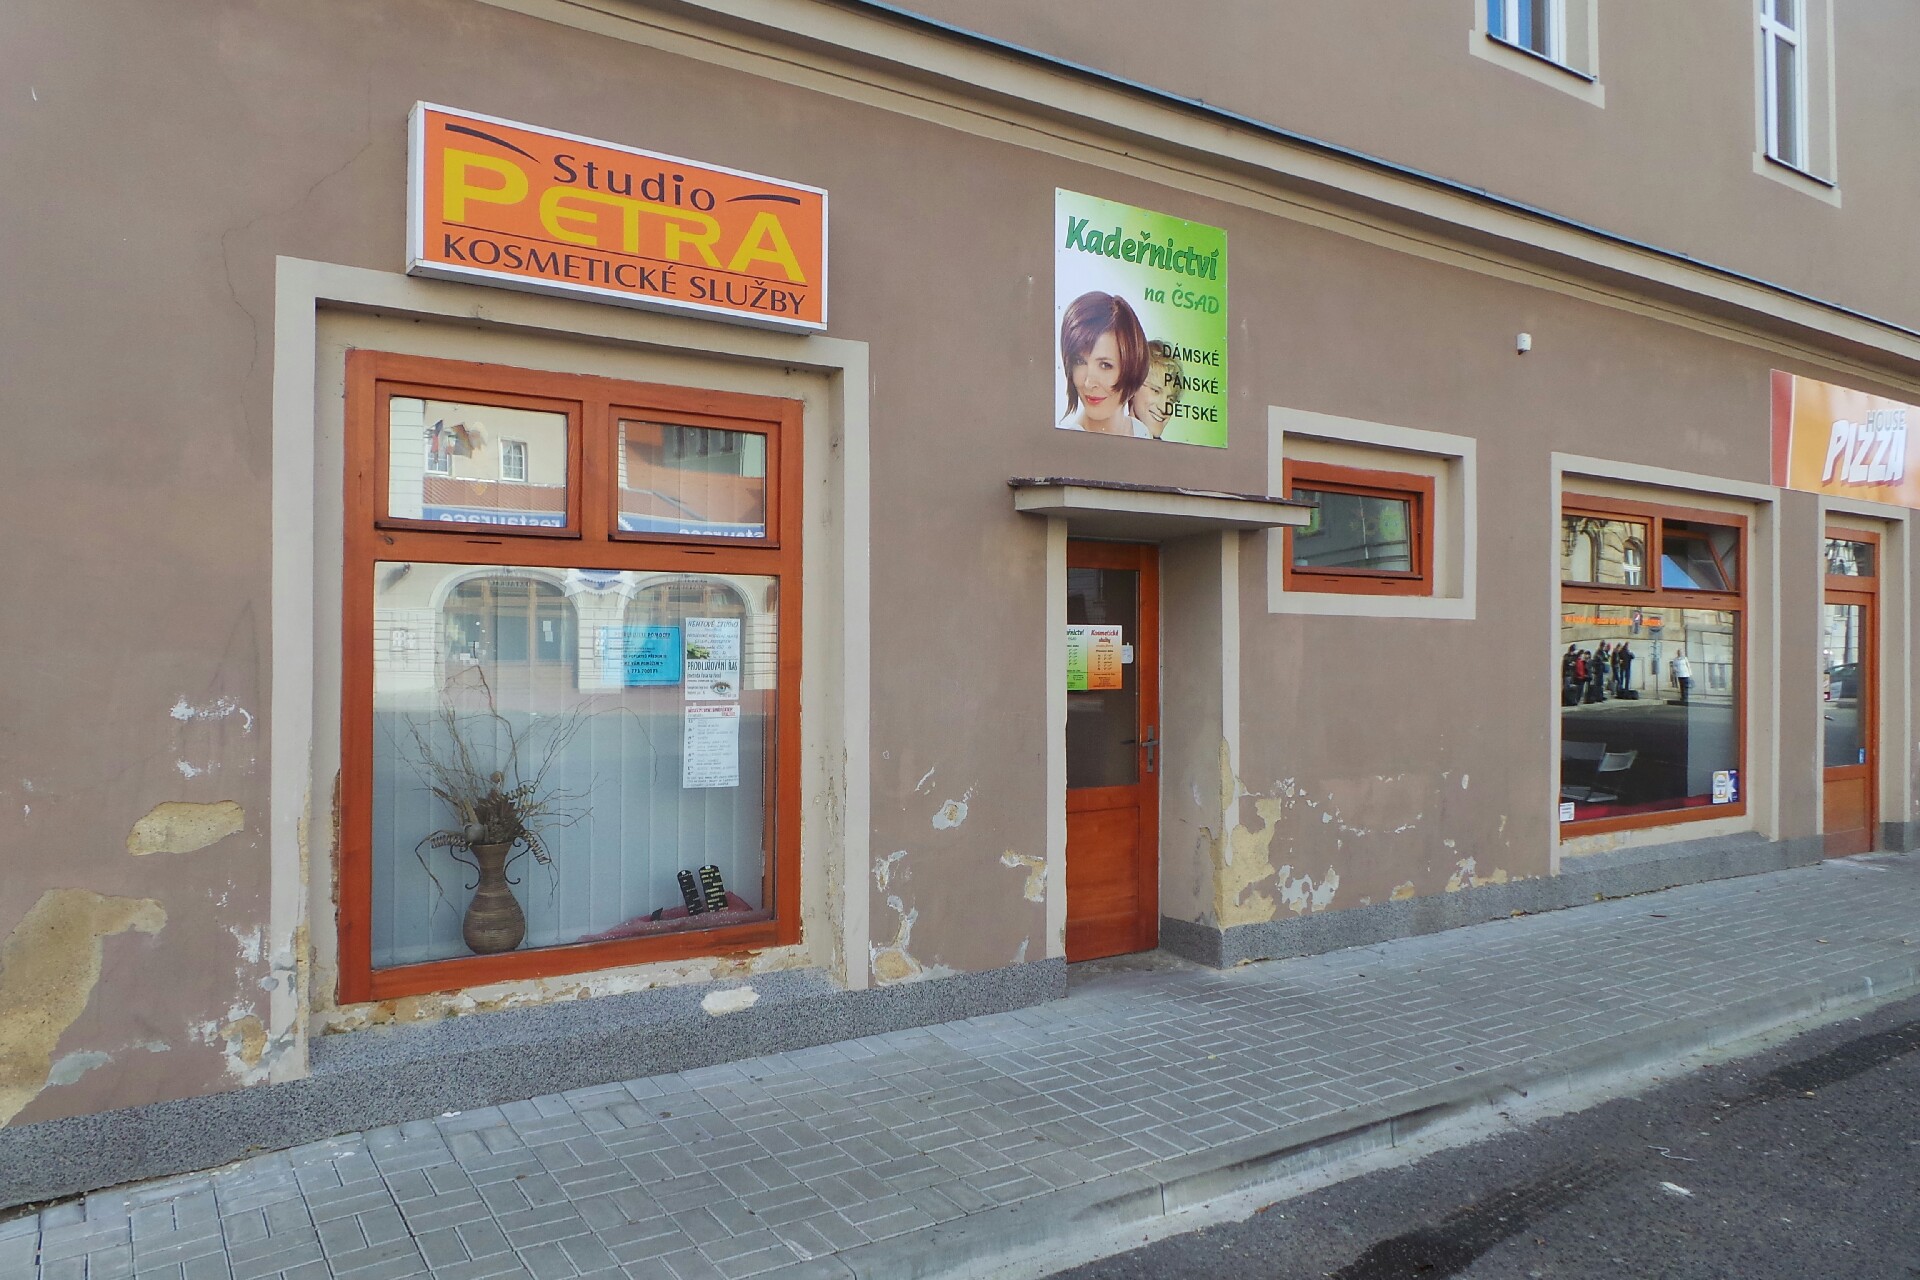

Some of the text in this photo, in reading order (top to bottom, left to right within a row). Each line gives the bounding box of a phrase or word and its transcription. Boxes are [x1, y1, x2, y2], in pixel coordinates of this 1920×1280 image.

[553, 154, 715, 211] Studio
[442, 147, 806, 283] PETRA
[1065, 215, 1219, 281] Kadeřnictví
[444, 233, 806, 315] KOSMETICKÉ SLUŽBY
[1144, 282, 1219, 314] na ČSAD
[1162, 343, 1220, 367] DÁMSKÉ
[1164, 372, 1219, 395] PÁNSKÉ
[1164, 400, 1218, 423] DĚTSKÉ
[1866, 410, 1906, 433] HOUSE
[1822, 419, 1907, 485] PIZZA
